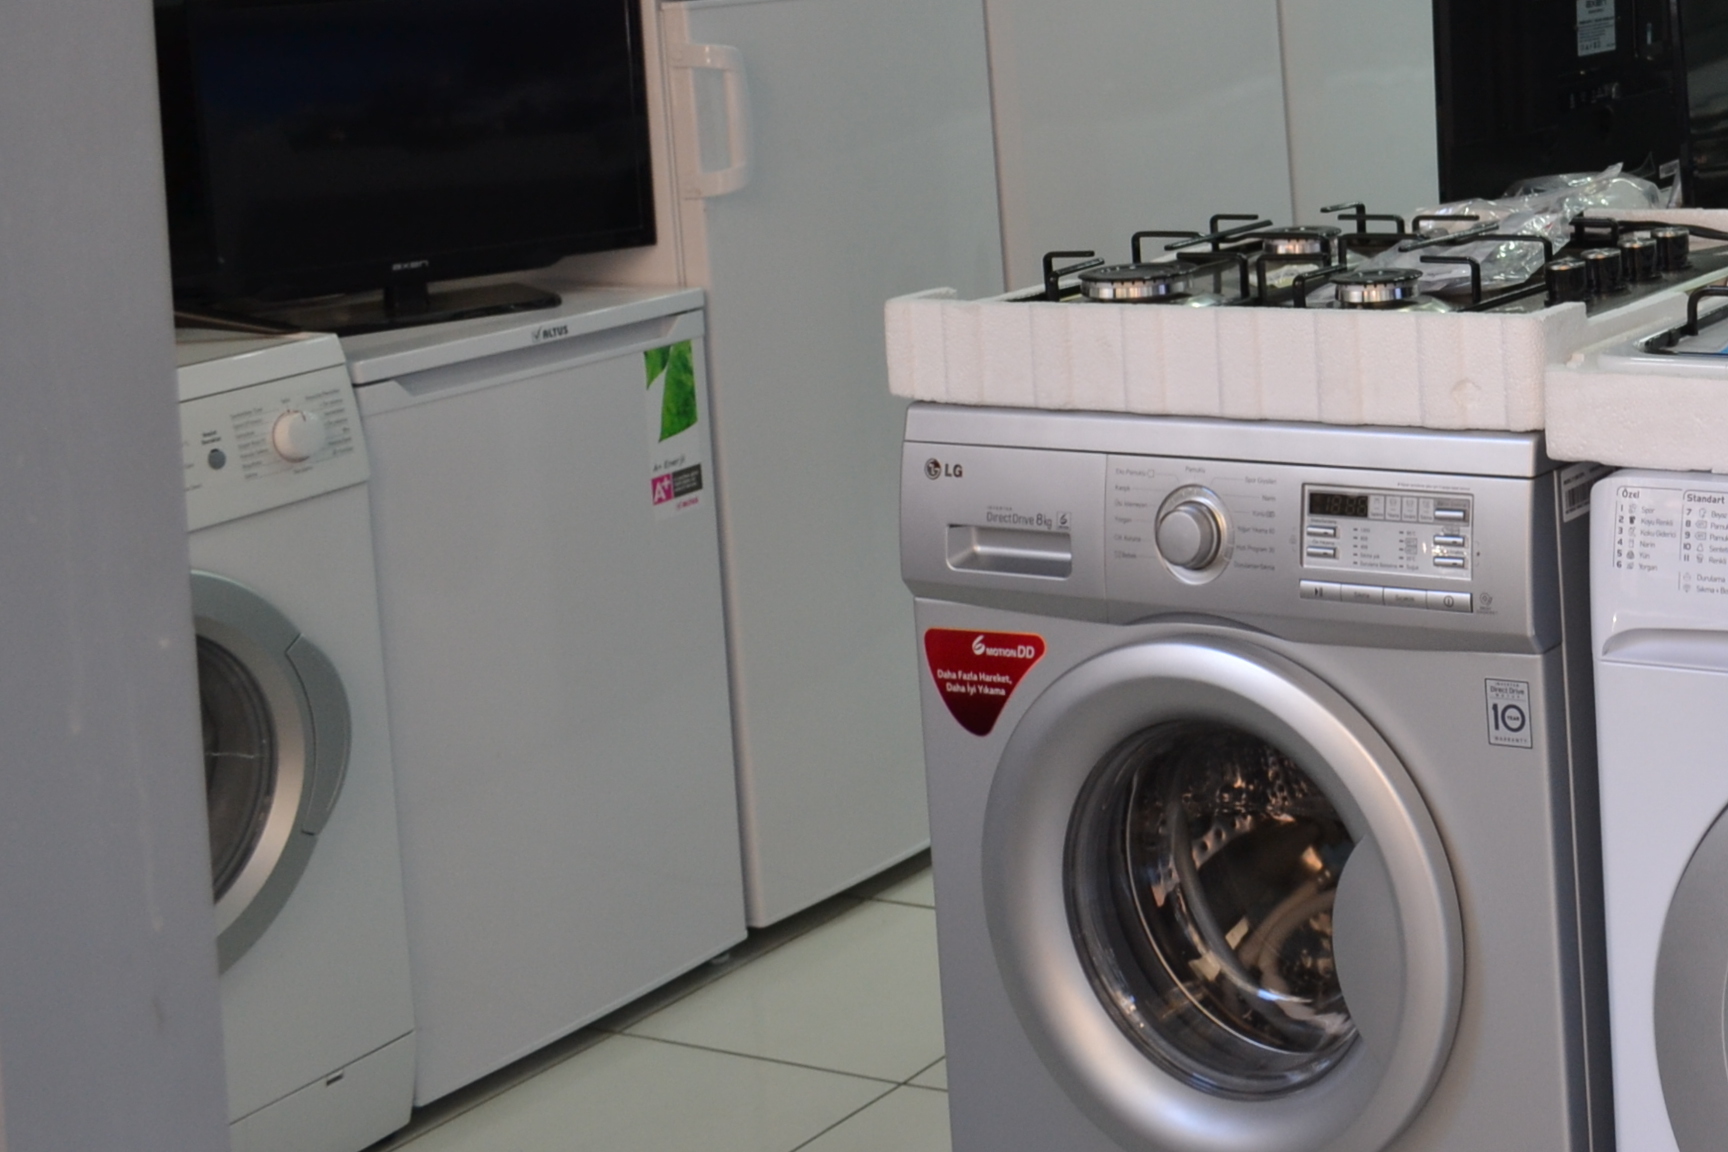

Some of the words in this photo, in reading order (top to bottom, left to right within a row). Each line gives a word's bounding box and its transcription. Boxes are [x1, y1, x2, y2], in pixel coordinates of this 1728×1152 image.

[542, 324, 569, 339] ALTUS
[945, 463, 963, 478] LG
[654, 475, 670, 503] A+
[1622, 488, 1640, 499] Özel
[1687, 493, 1725, 504] Standart
[937, 669, 957, 680] Daha
[958, 670, 978, 681] Fazla
[946, 682, 966, 693] Daha
[978, 685, 1006, 696] Yıkama
[1490, 686, 1508, 694] Direct
[1509, 687, 1525, 695] Drive
[1492, 703, 1526, 733] 10
